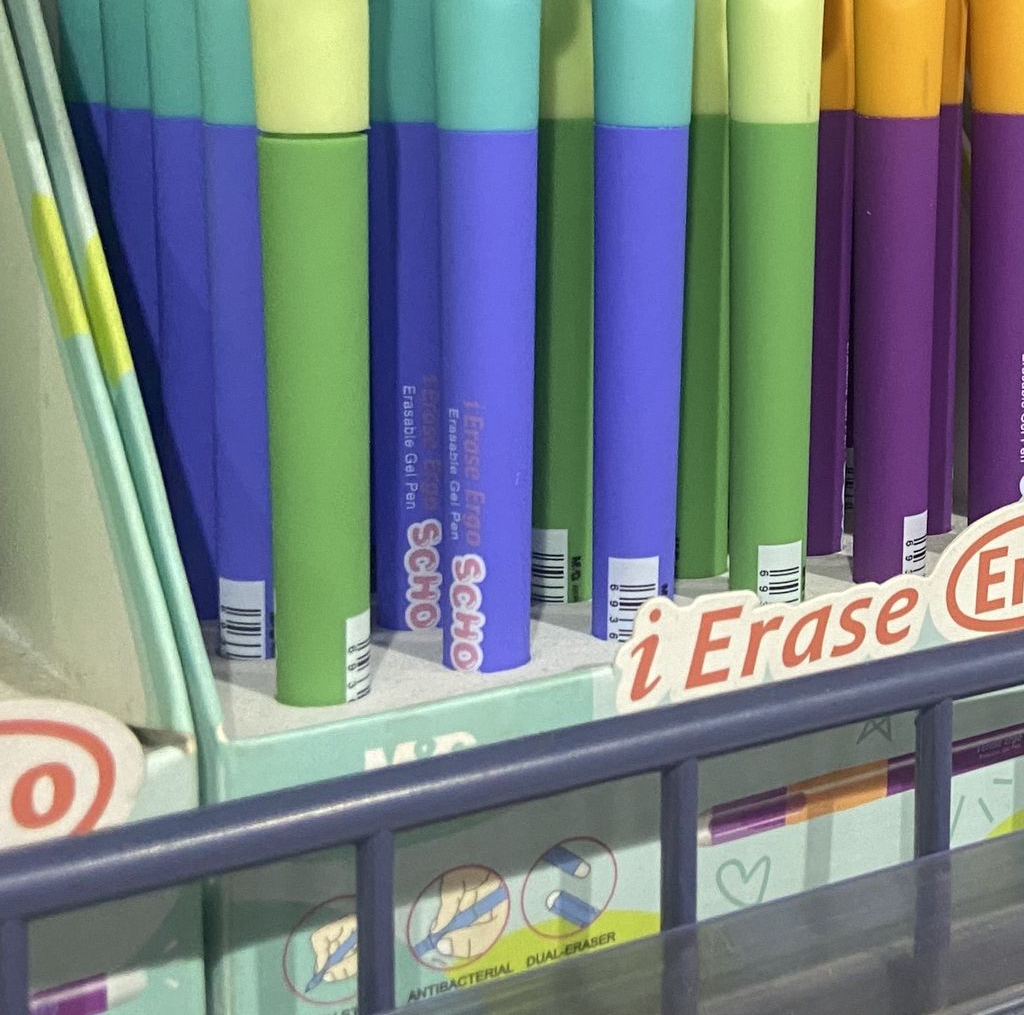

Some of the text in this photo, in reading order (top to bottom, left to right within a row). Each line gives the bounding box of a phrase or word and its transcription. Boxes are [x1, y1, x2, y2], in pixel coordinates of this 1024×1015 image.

[403, 385, 418, 510] Erasable Gel Pen
[448, 408, 461, 541] Erasable Gel Pen
[404, 518, 442, 631] SCHO
[450, 553, 486, 672] SCHO
[630, 607, 662, 703] i
[684, 587, 920, 691] Erase
[407, 961, 514, 1003] ANTIBACTERIAL
[525, 931, 617, 969] DUAL-ERASER
